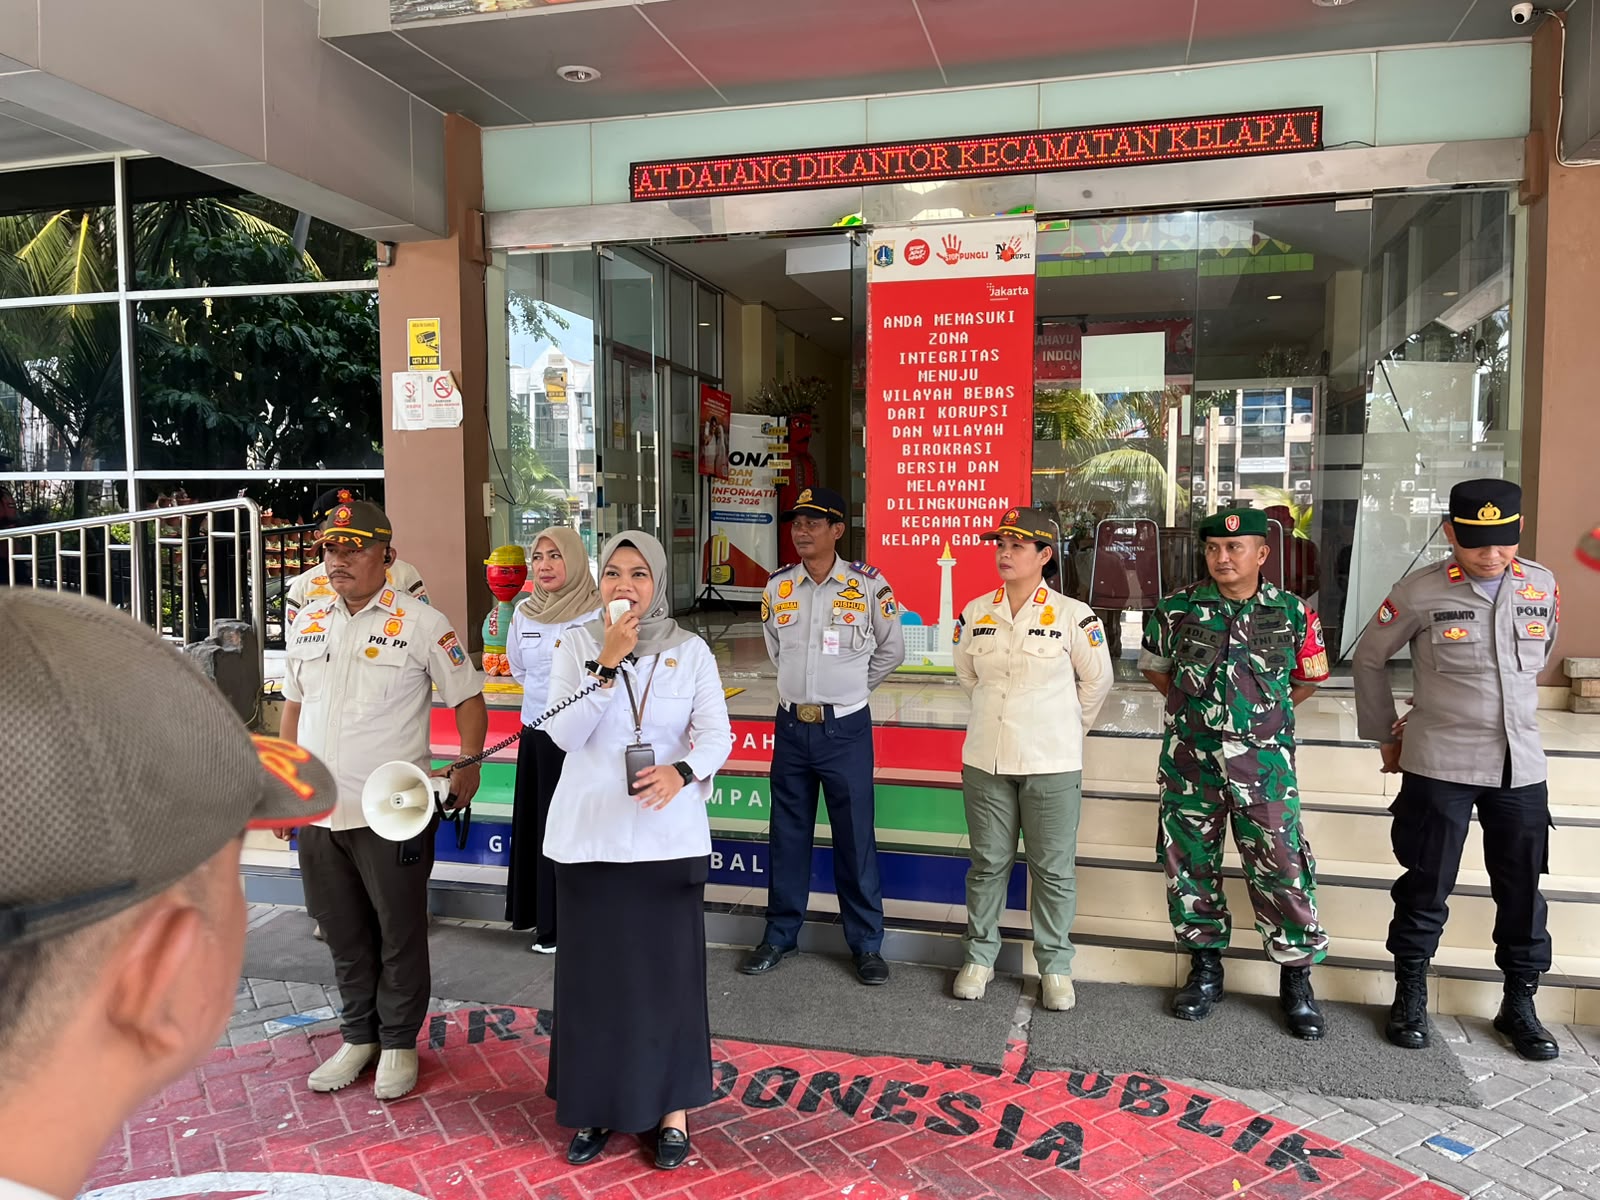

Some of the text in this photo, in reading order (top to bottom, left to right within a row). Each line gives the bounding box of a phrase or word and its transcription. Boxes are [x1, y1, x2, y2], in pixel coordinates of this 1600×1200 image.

[639, 116, 1301, 192] AT DATANG DIKANTOR KECAMATAN KELAPA
[960, 251, 989, 261] PUNGLI
[883, 310, 1015, 329] ANDA MEMASUKI
[928, 332, 969, 345] ZONA
[899, 349, 1000, 365] INTEGRITAS
[918, 368, 979, 383] MENUJU
[883, 385, 1016, 402] WILAYAH BEBAS
[887, 404, 1008, 420] DARI KORUPSI
[892, 423, 1004, 439] DAN WILAYAH
[902, 442, 992, 456] BIROKRASI
[897, 460, 1000, 475] BERSIH DAN
[712, 477, 753, 487] PUBLIK
[907, 479, 987, 493] MELAYANI
[711, 496, 732, 504] 2025
[738, 496, 760, 505] 2026
[887, 497, 1009, 511] DILINGKUNGAN
[902, 515, 993, 529] KECAMATAN
[882, 532, 998, 547] KELAPA GAD
[833, 601, 866, 612] DISHUB
[1516, 606, 1548, 618] POLRI
[1028, 628, 1062, 639] POL PP
[1252, 635, 1292, 646] TNI AD
[368, 635, 408, 649] POL PP
[710, 852, 764, 873] BAL
